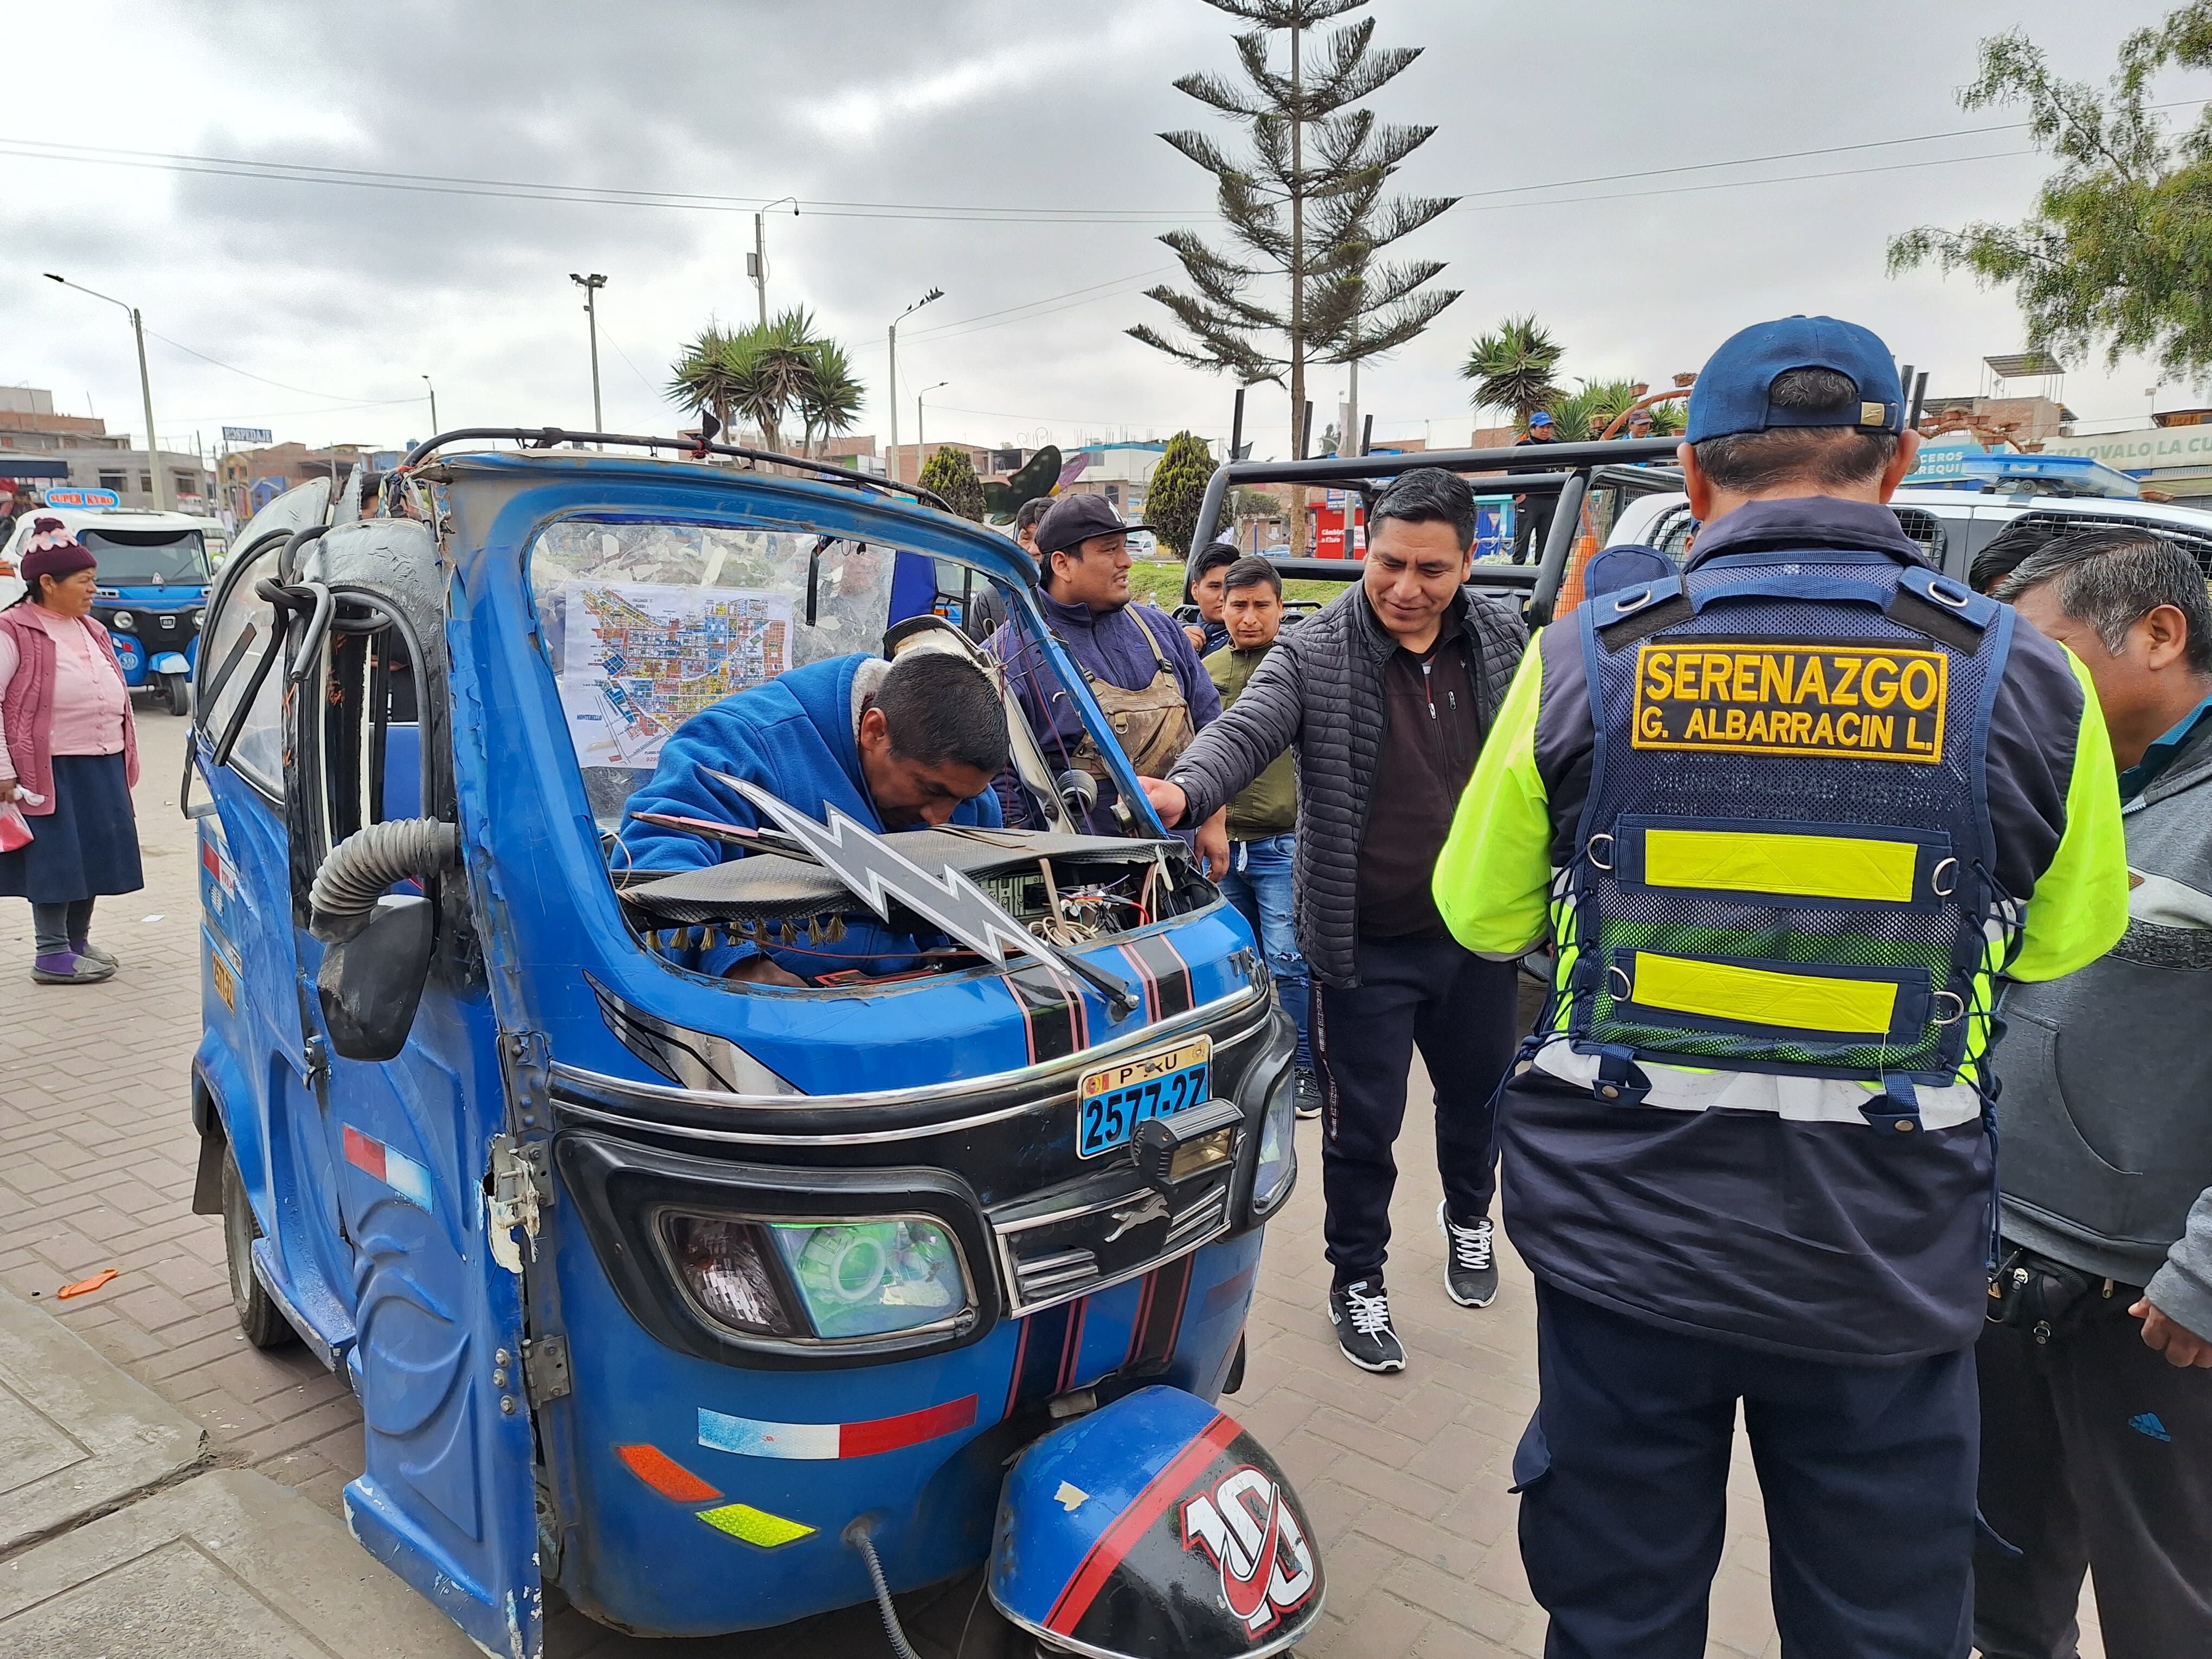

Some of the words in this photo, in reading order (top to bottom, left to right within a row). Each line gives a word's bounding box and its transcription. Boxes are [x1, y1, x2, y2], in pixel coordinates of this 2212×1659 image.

[224, 428, 271, 442] HOSPEDAJE
[1920, 452, 1963, 464] CEROS
[2087, 442, 2151, 459] OVALO
[2156, 439, 2181, 455] LA
[50, 494, 82, 505] SUPER
[1646, 653, 1938, 710] SERENAZGO
[1641, 706, 1669, 739] G.
[1684, 708, 1894, 748] ALBARRACIN
[1907, 716, 1933, 750] L.
[1085, 1066, 1206, 1150] 2577-27
